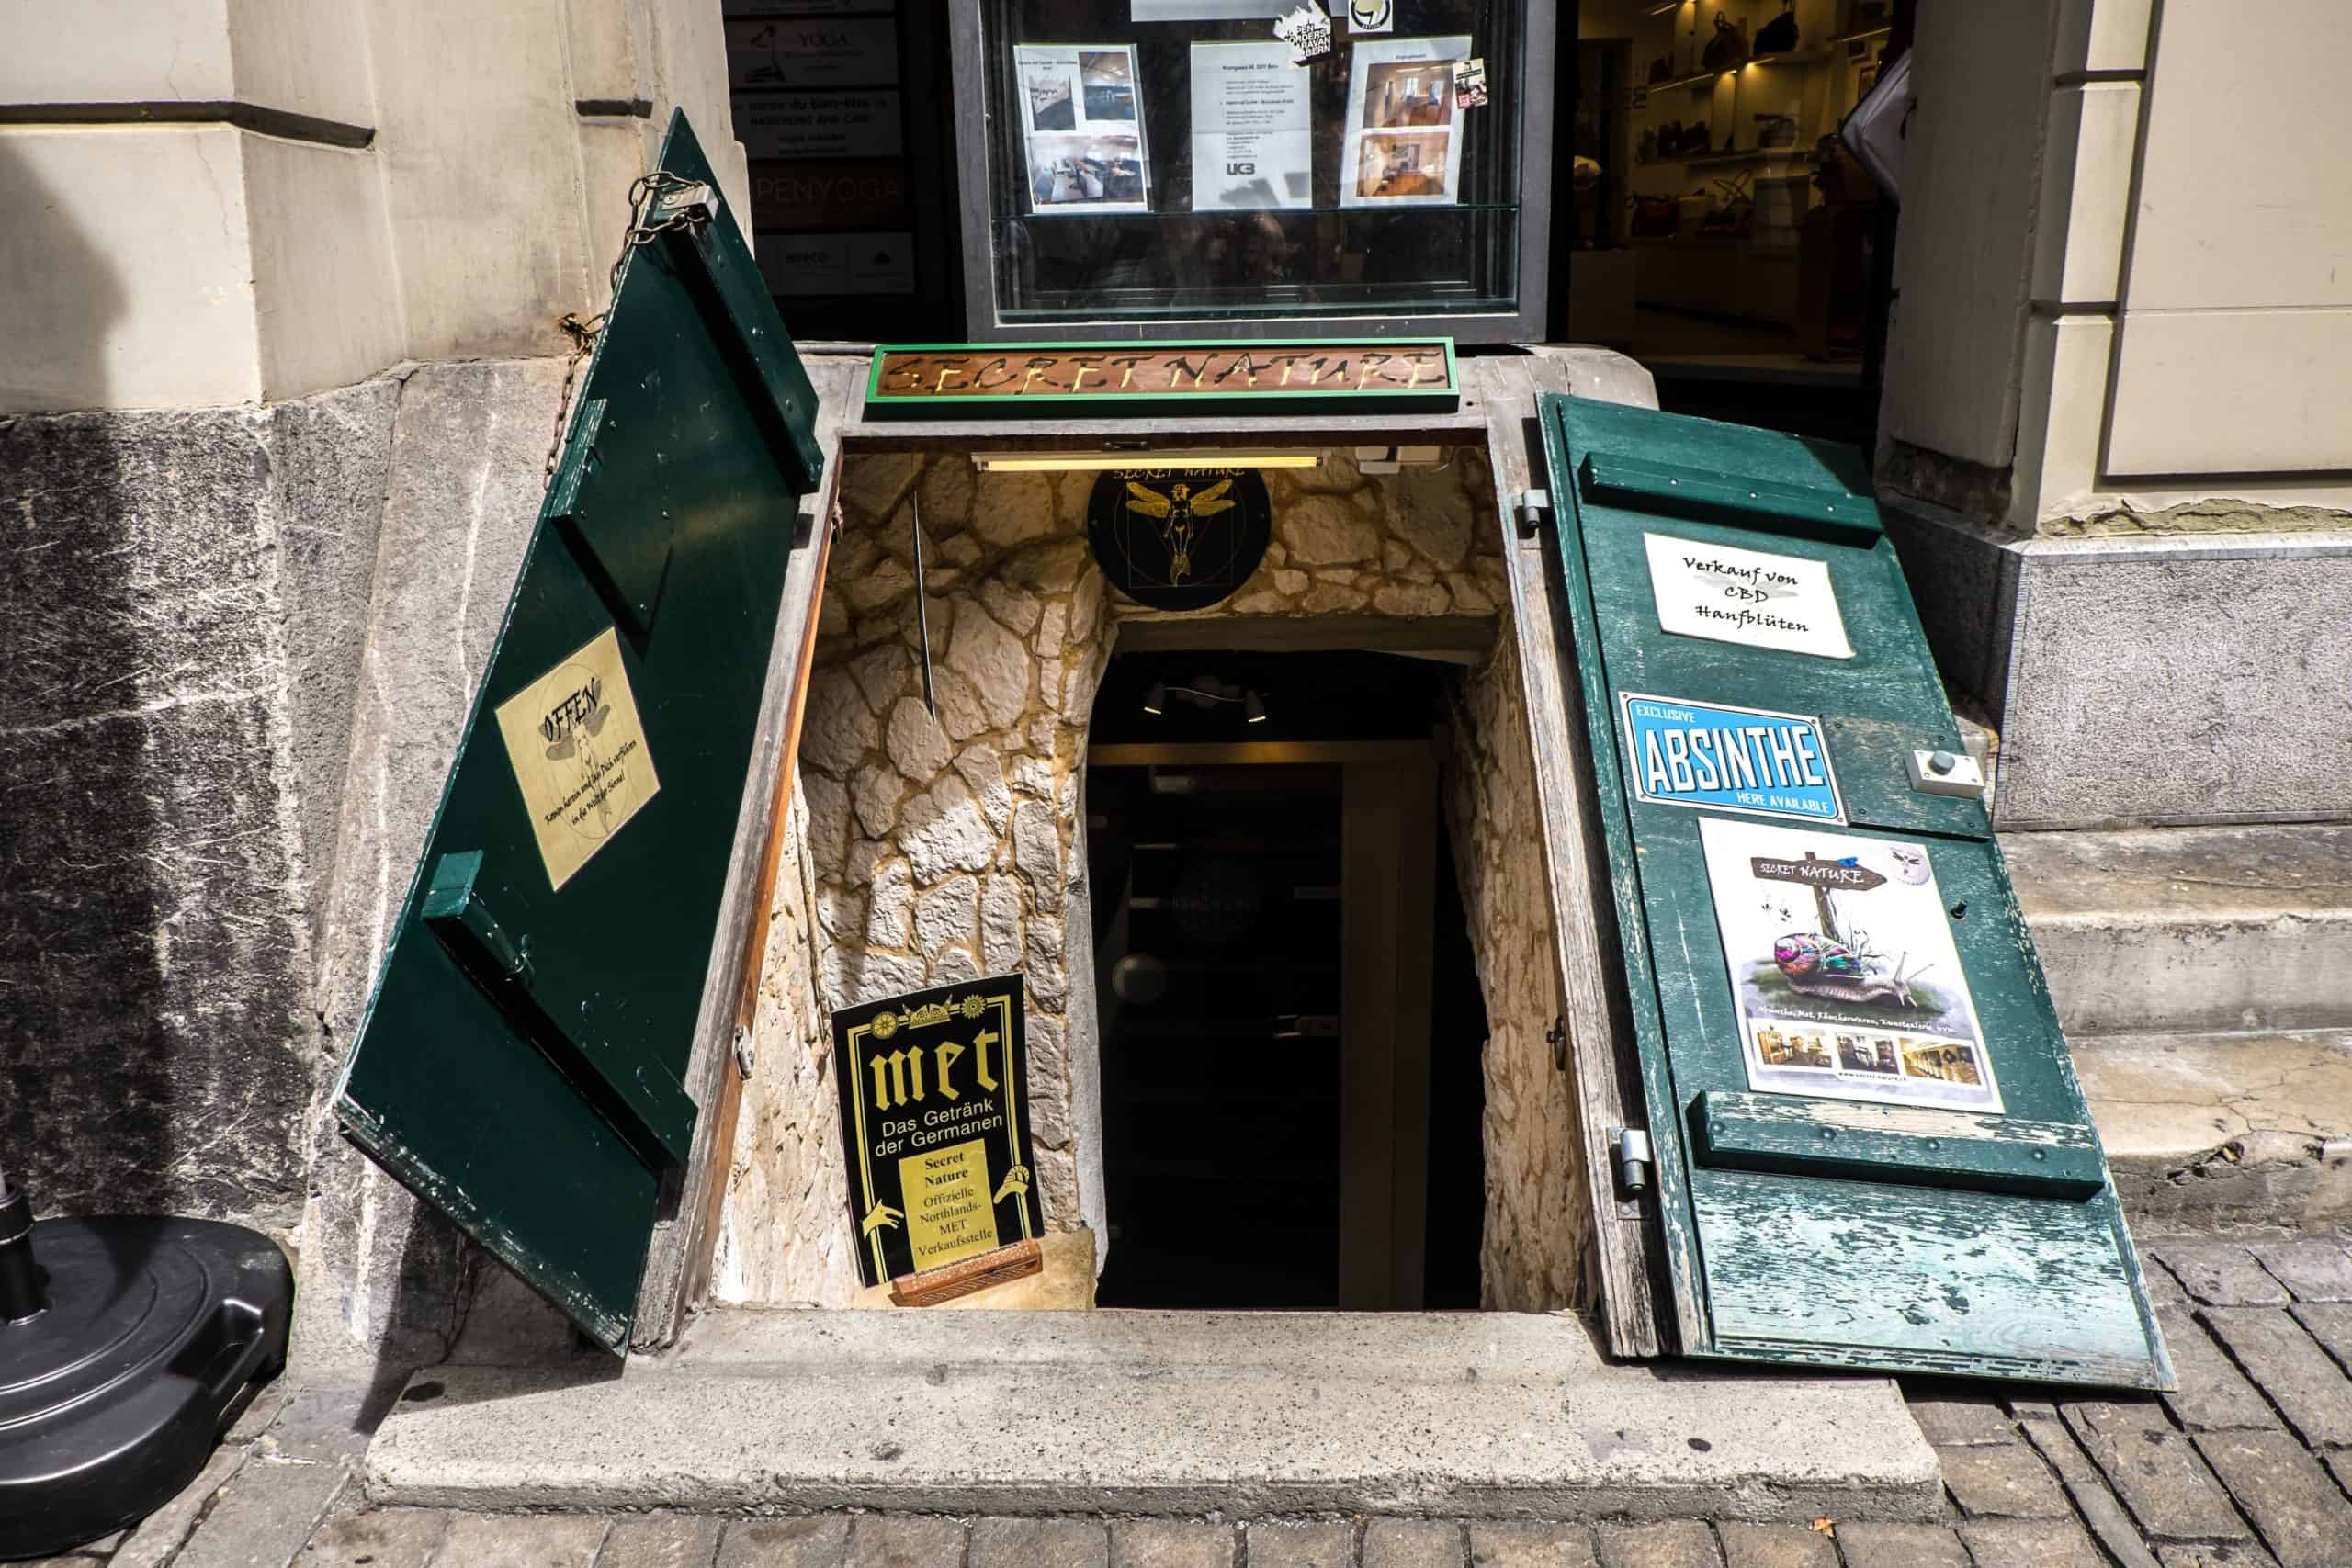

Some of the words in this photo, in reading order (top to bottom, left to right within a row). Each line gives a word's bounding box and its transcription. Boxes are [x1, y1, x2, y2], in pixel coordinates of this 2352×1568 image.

[797, 31, 849, 48] YOGA
[752, 176, 901, 202] PENYOGA
[885, 355, 1154, 394] SECRET
[1163, 352, 1448, 391] NATURE
[1682, 557, 1762, 586] Verkauf
[1765, 572, 1798, 585] von
[1724, 586, 1769, 603] CBD
[1695, 605, 1809, 632] Hanfblüten
[544, 677, 597, 742] OFFEN
[1635, 704, 1696, 724] EXCLUSIVE
[1645, 726, 1826, 793] ABSINTHE
[1736, 792, 1766, 806] HERE
[1770, 795, 1830, 813] AVAILABLE
[1758, 863, 1797, 875] SECRET
[1800, 866, 1864, 883] NATURE
[869, 1028, 999, 1111] met
[882, 1118, 917, 1137] Das
[924, 1098, 993, 1127] Getränk
[875, 1139, 904, 1156] der
[911, 1114, 1002, 1147] Germanen
[924, 1151, 964, 1170] Secret
[924, 1168, 968, 1187] Nature
[923, 1187, 974, 1208] Offizielle
[919, 1201, 981, 1225] Northlands-
[939, 1219, 967, 1235] MET
[918, 1230, 993, 1257] Verkaufsstelle
